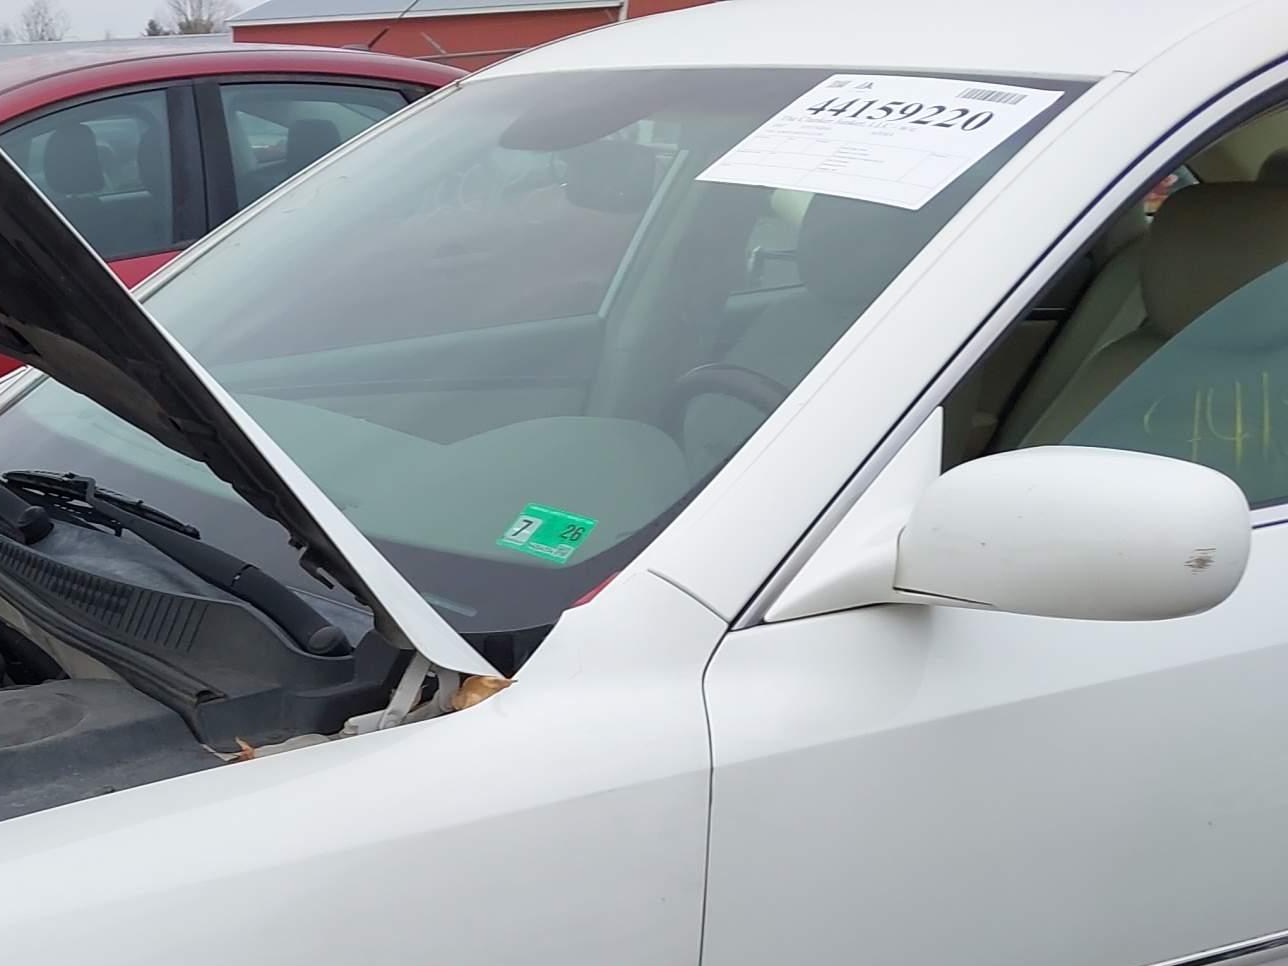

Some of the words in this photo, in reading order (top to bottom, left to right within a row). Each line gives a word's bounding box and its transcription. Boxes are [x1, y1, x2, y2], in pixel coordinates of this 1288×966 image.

[806, 97, 994, 132] 44159220
[512, 518, 534, 537] 7
[559, 524, 586, 542] 26
